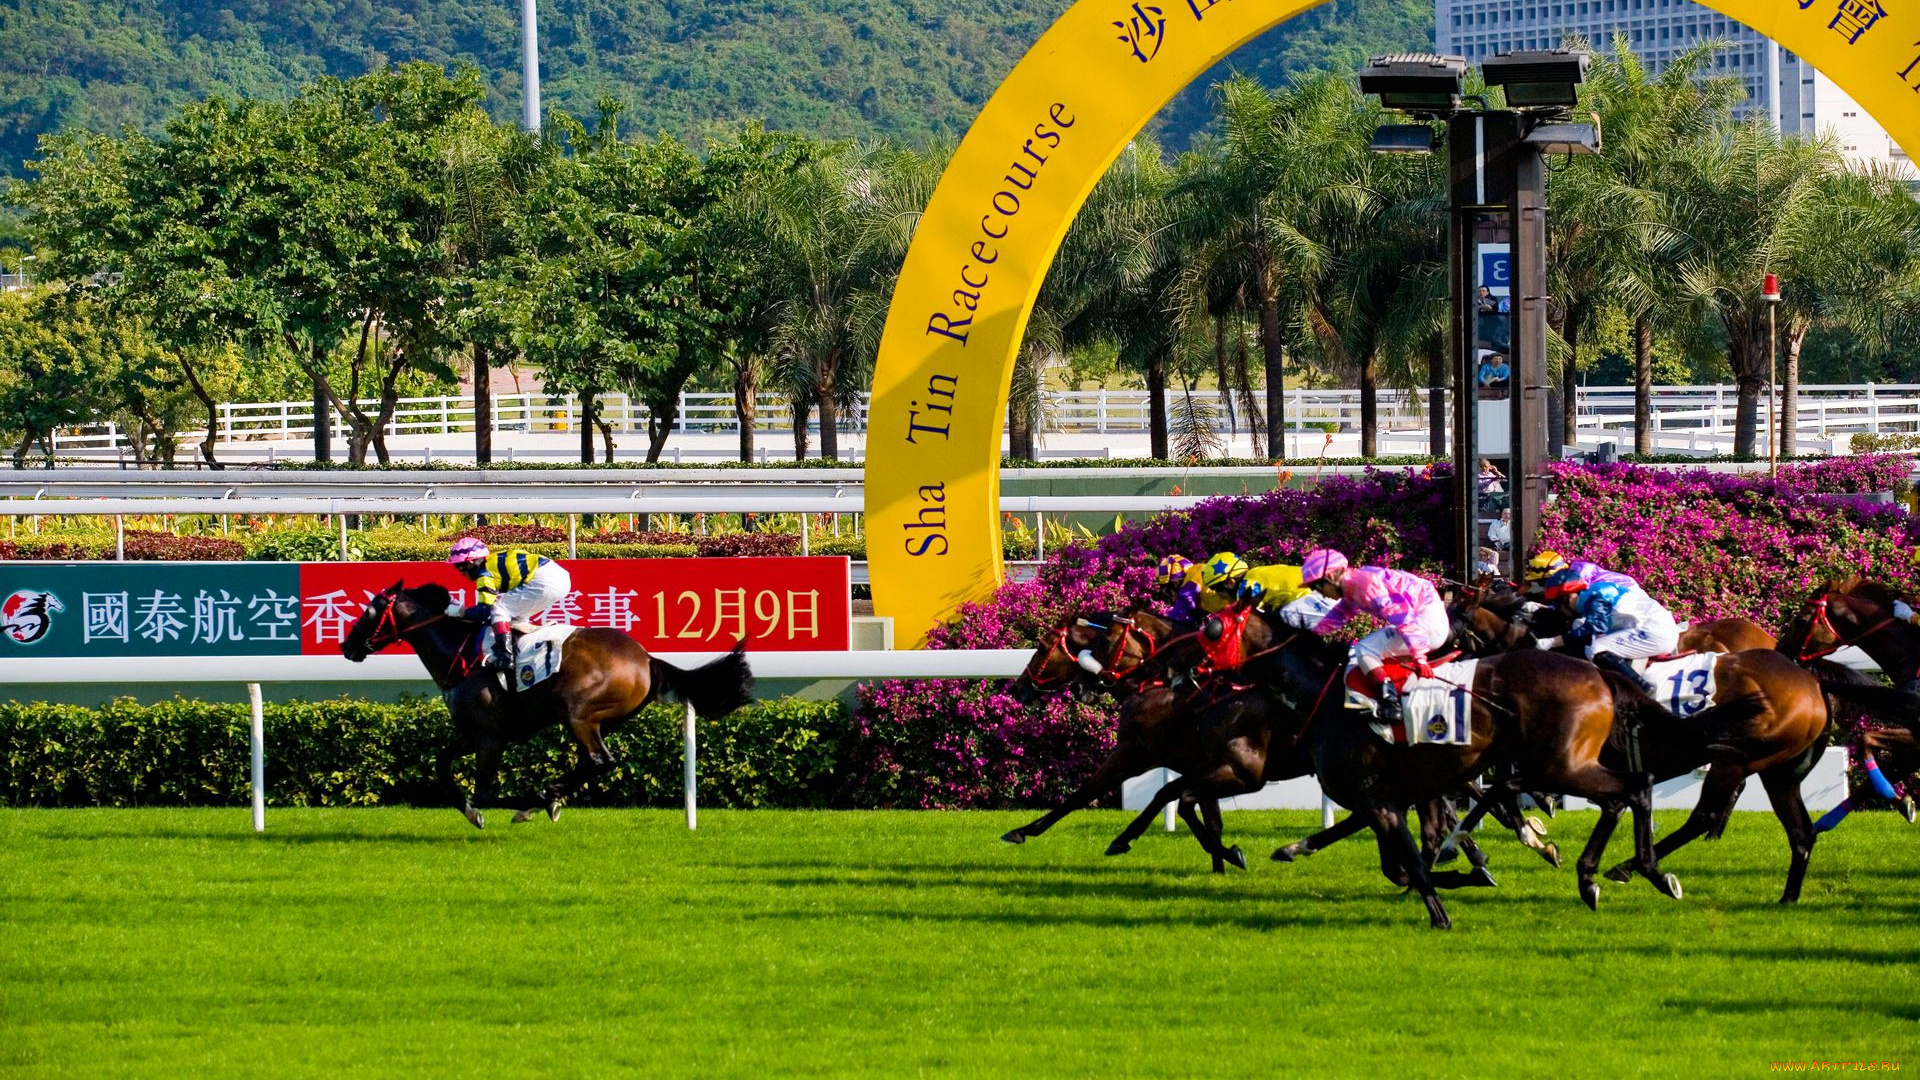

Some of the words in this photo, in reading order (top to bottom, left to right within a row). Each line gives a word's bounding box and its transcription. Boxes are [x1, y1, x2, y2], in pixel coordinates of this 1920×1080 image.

[926, 102, 1075, 347] Racecourse
[906, 375, 958, 444] Tin
[904, 482, 948, 556] Sha
[82, 588, 300, 644] 國泰航空
[653, 588, 820, 642] 12月9日
[1450, 684, 1466, 742] 1
[1668, 669, 1710, 716] 13
